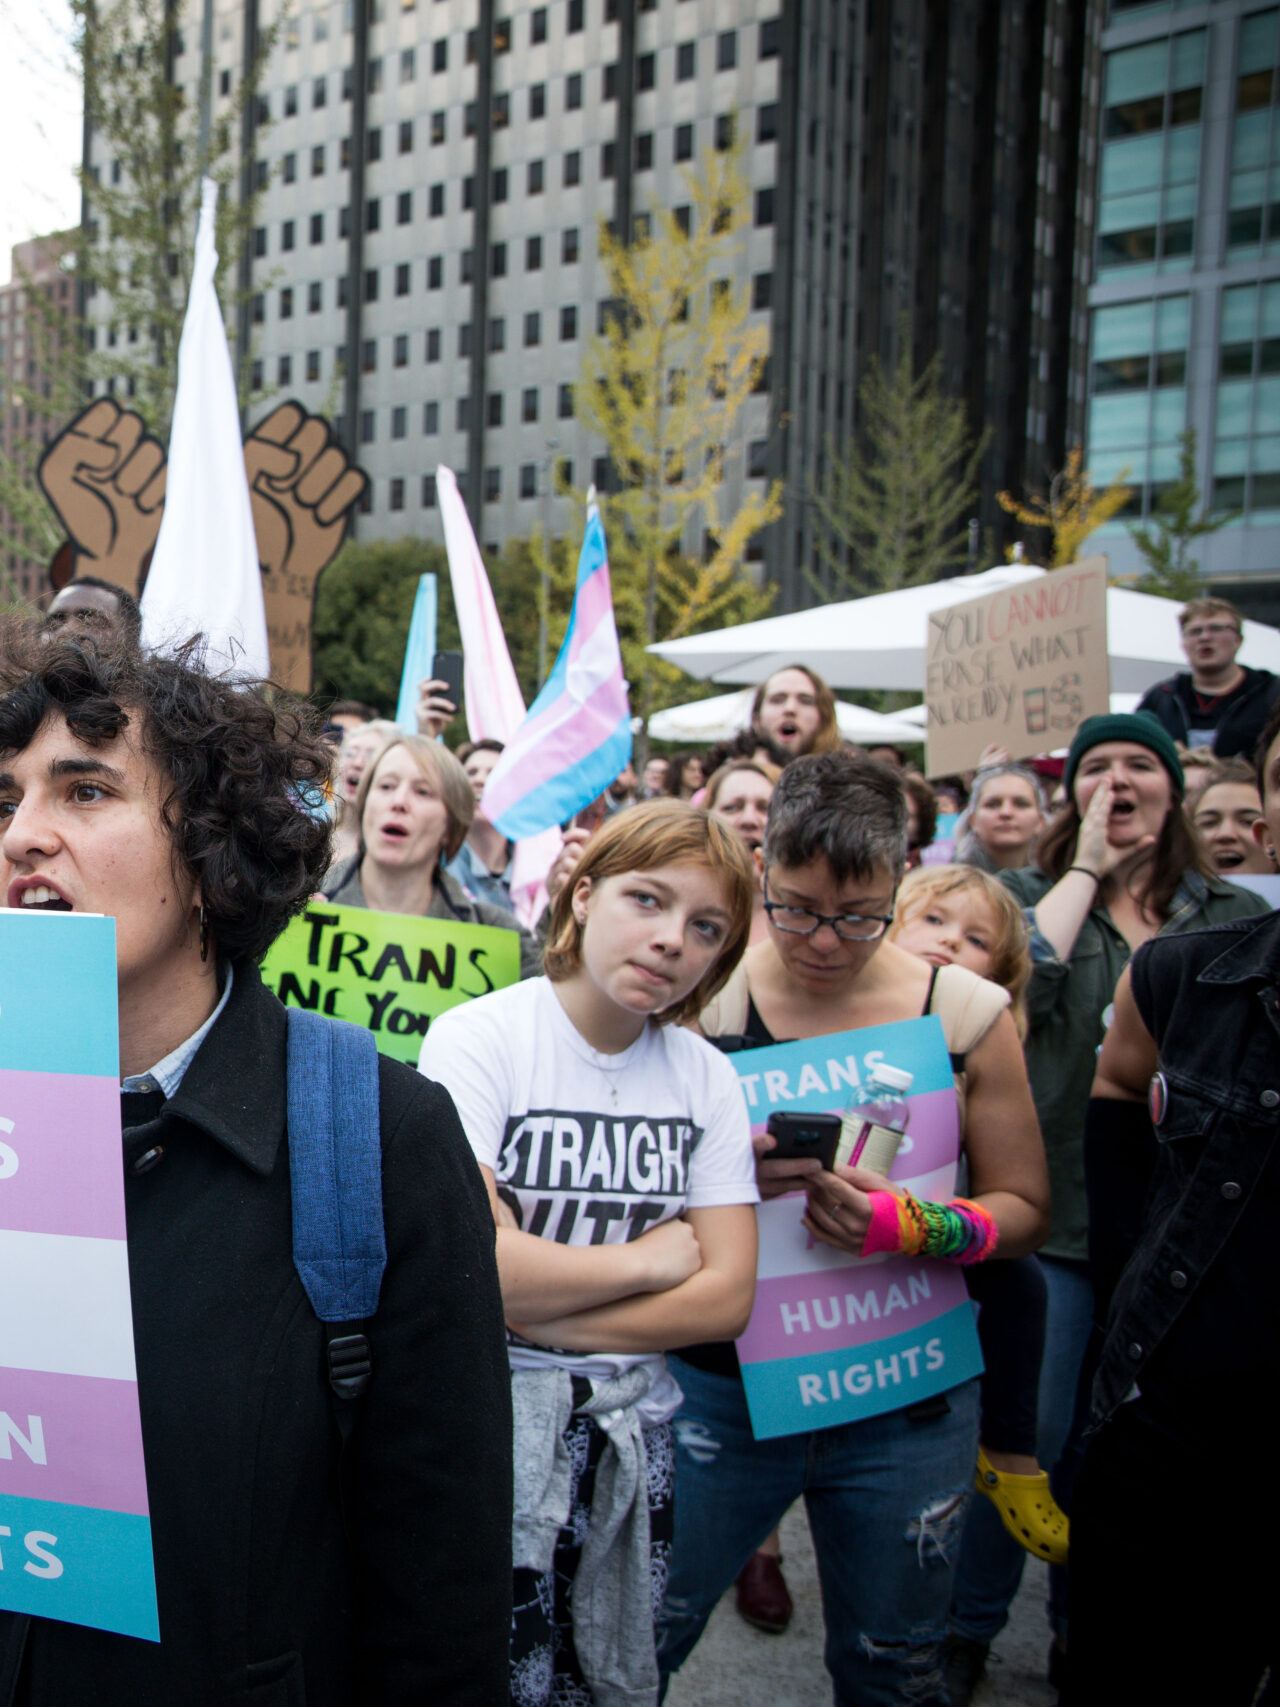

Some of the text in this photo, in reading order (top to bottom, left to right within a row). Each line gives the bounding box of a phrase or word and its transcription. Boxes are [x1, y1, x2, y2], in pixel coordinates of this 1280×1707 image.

[929, 572, 1098, 659] YOU CANNOT
[1010, 625, 1092, 671] WHAT
[304, 912, 495, 998] TRANS
[497, 1116, 695, 1194] STRAIGH
[779, 1269, 932, 1335] HUMAN
[798, 1338, 946, 1406] RIGHTS
